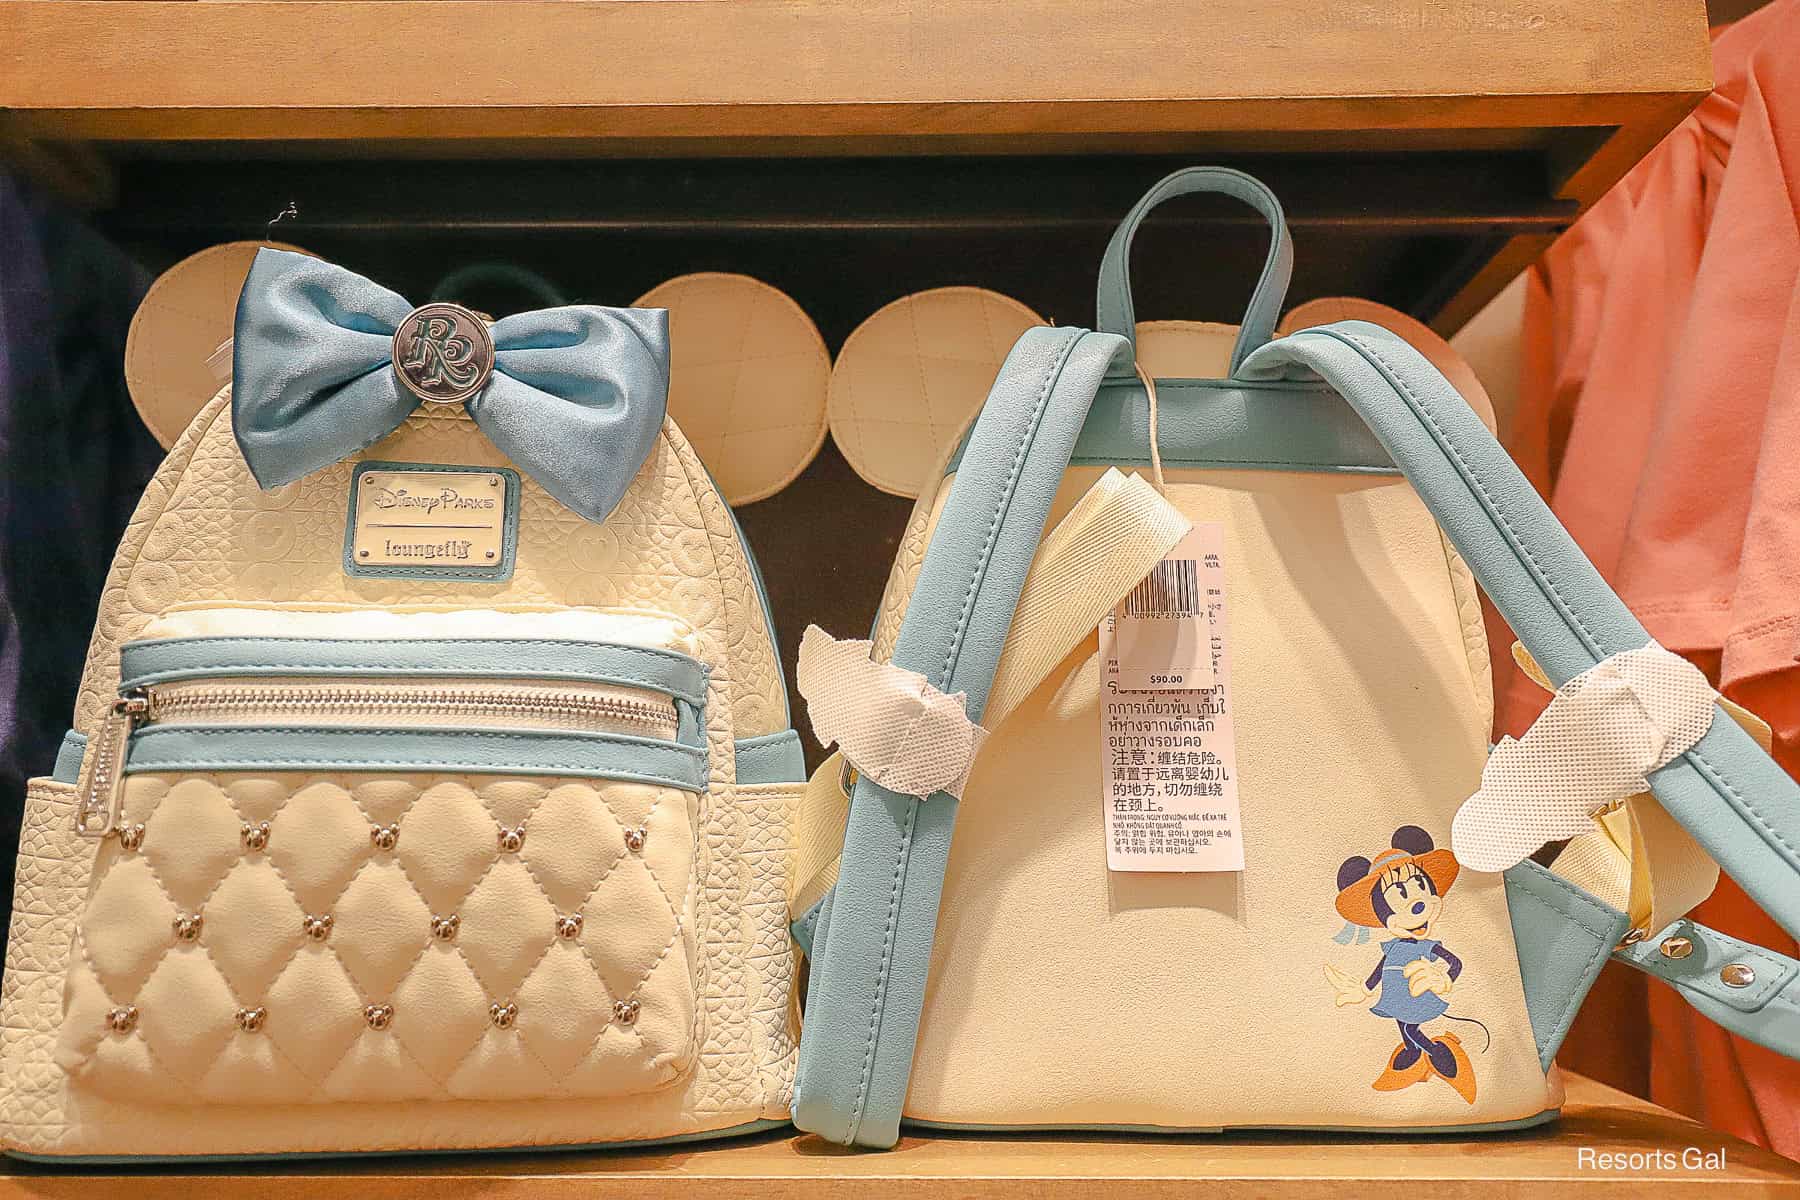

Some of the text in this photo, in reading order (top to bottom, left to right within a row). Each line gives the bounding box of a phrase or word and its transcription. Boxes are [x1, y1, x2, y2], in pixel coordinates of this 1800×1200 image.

[384, 539, 473, 559] loungefly
[1149, 674, 1183, 685] $90.00
[1112, 767, 1230, 781] 请置于远离婴幼儿
[1113, 798, 1165, 812] 在颈上。
